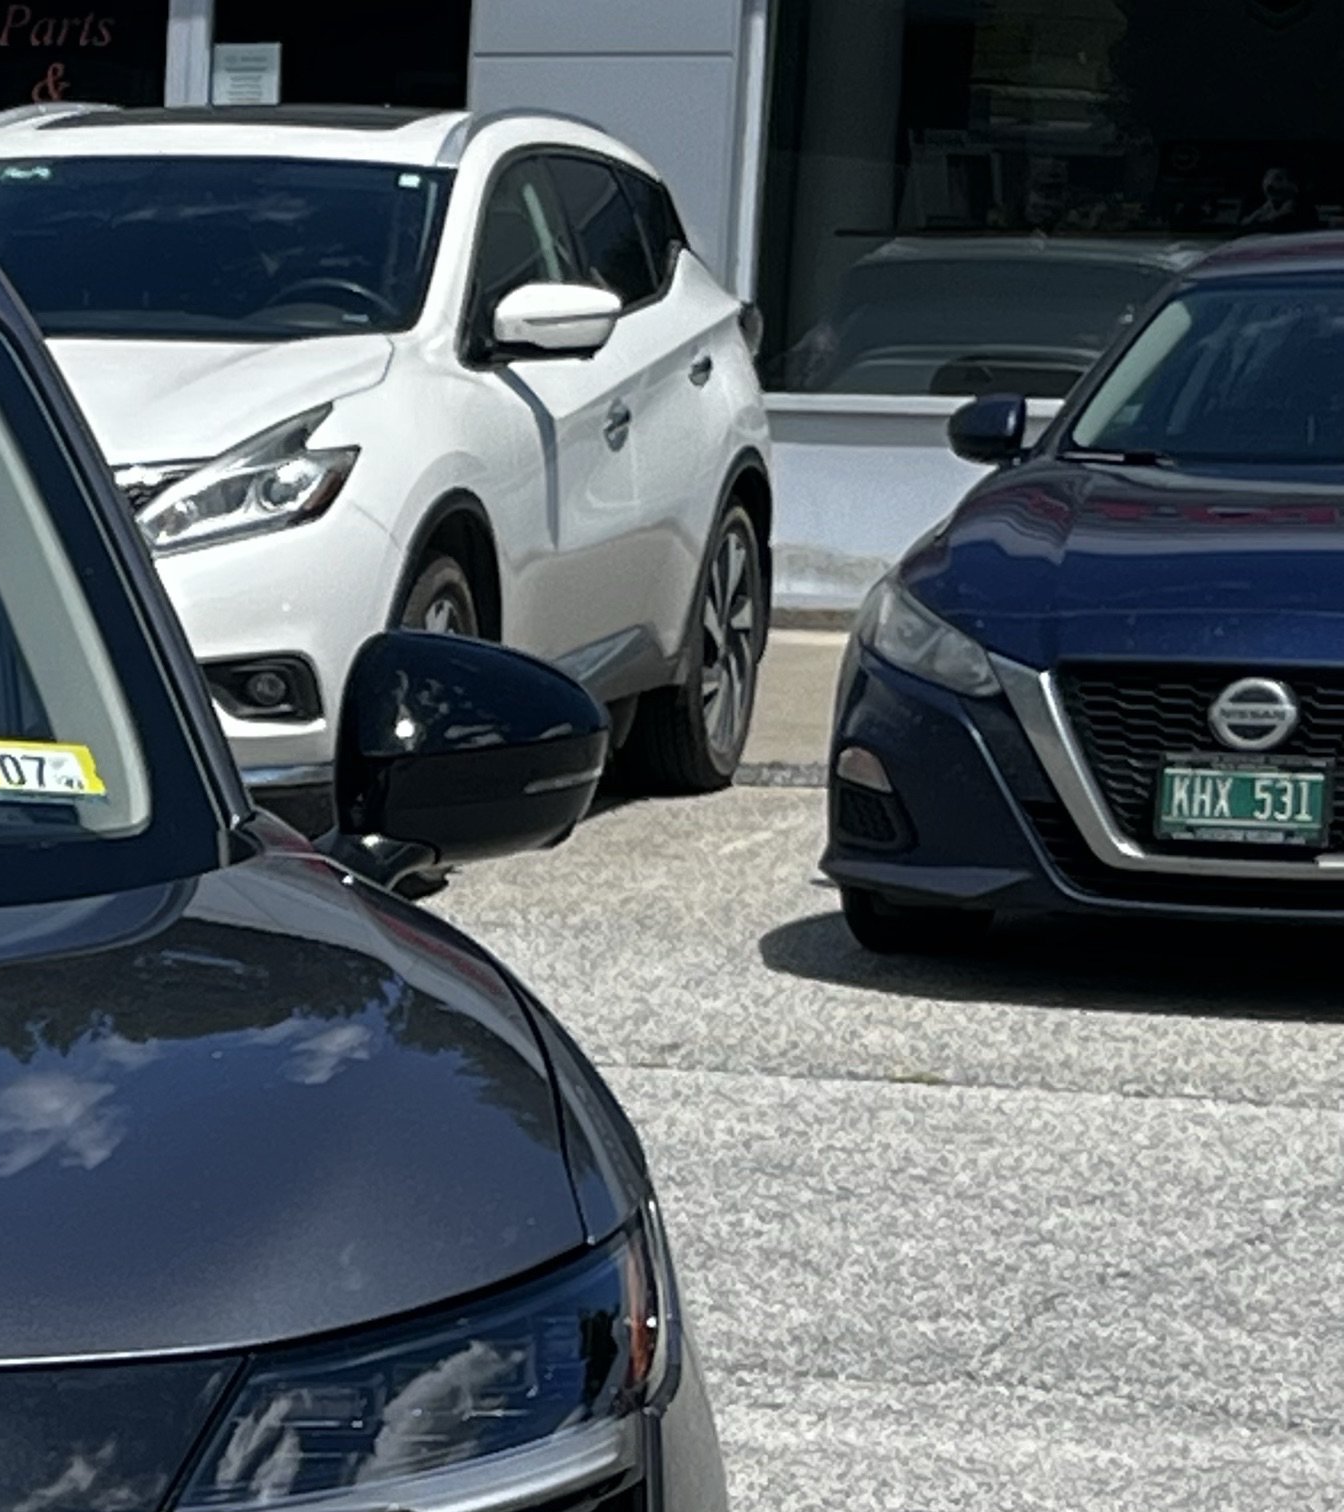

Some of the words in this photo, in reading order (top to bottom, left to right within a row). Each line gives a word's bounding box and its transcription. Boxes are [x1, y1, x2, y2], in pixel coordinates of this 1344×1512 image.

[31, 62, 71, 102] &
[1171, 775, 1233, 818] KHX
[1253, 778, 1313, 822] 531
